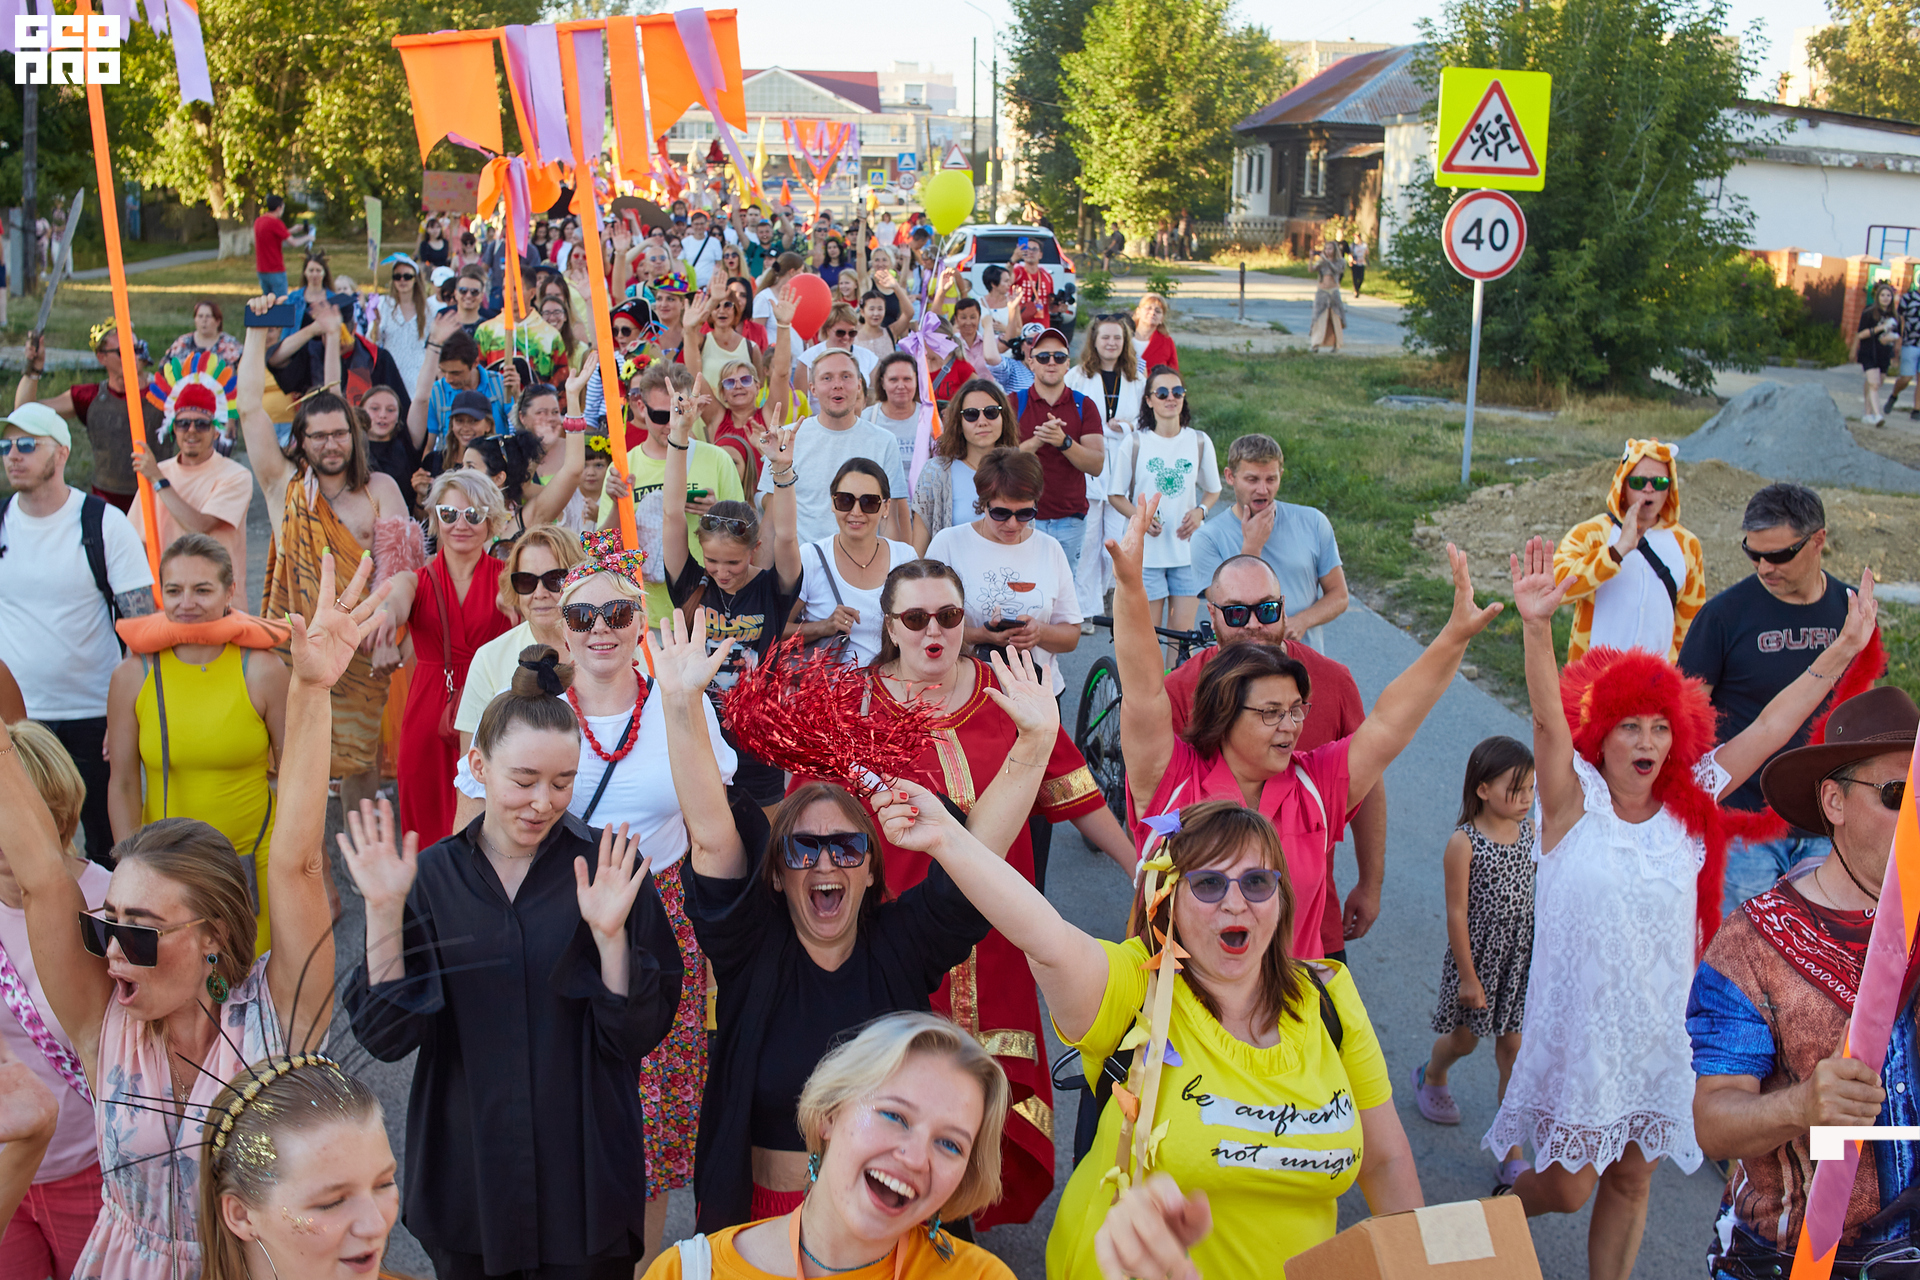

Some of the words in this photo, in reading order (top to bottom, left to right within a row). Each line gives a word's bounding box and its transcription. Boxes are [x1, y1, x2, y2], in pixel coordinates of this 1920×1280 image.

[1461, 217, 1509, 252] 40
[635, 485, 664, 501] TAK
[1181, 1074, 1215, 1107] be
[1235, 1088, 1352, 1137] authenti
[1210, 1143, 1268, 1163] not
